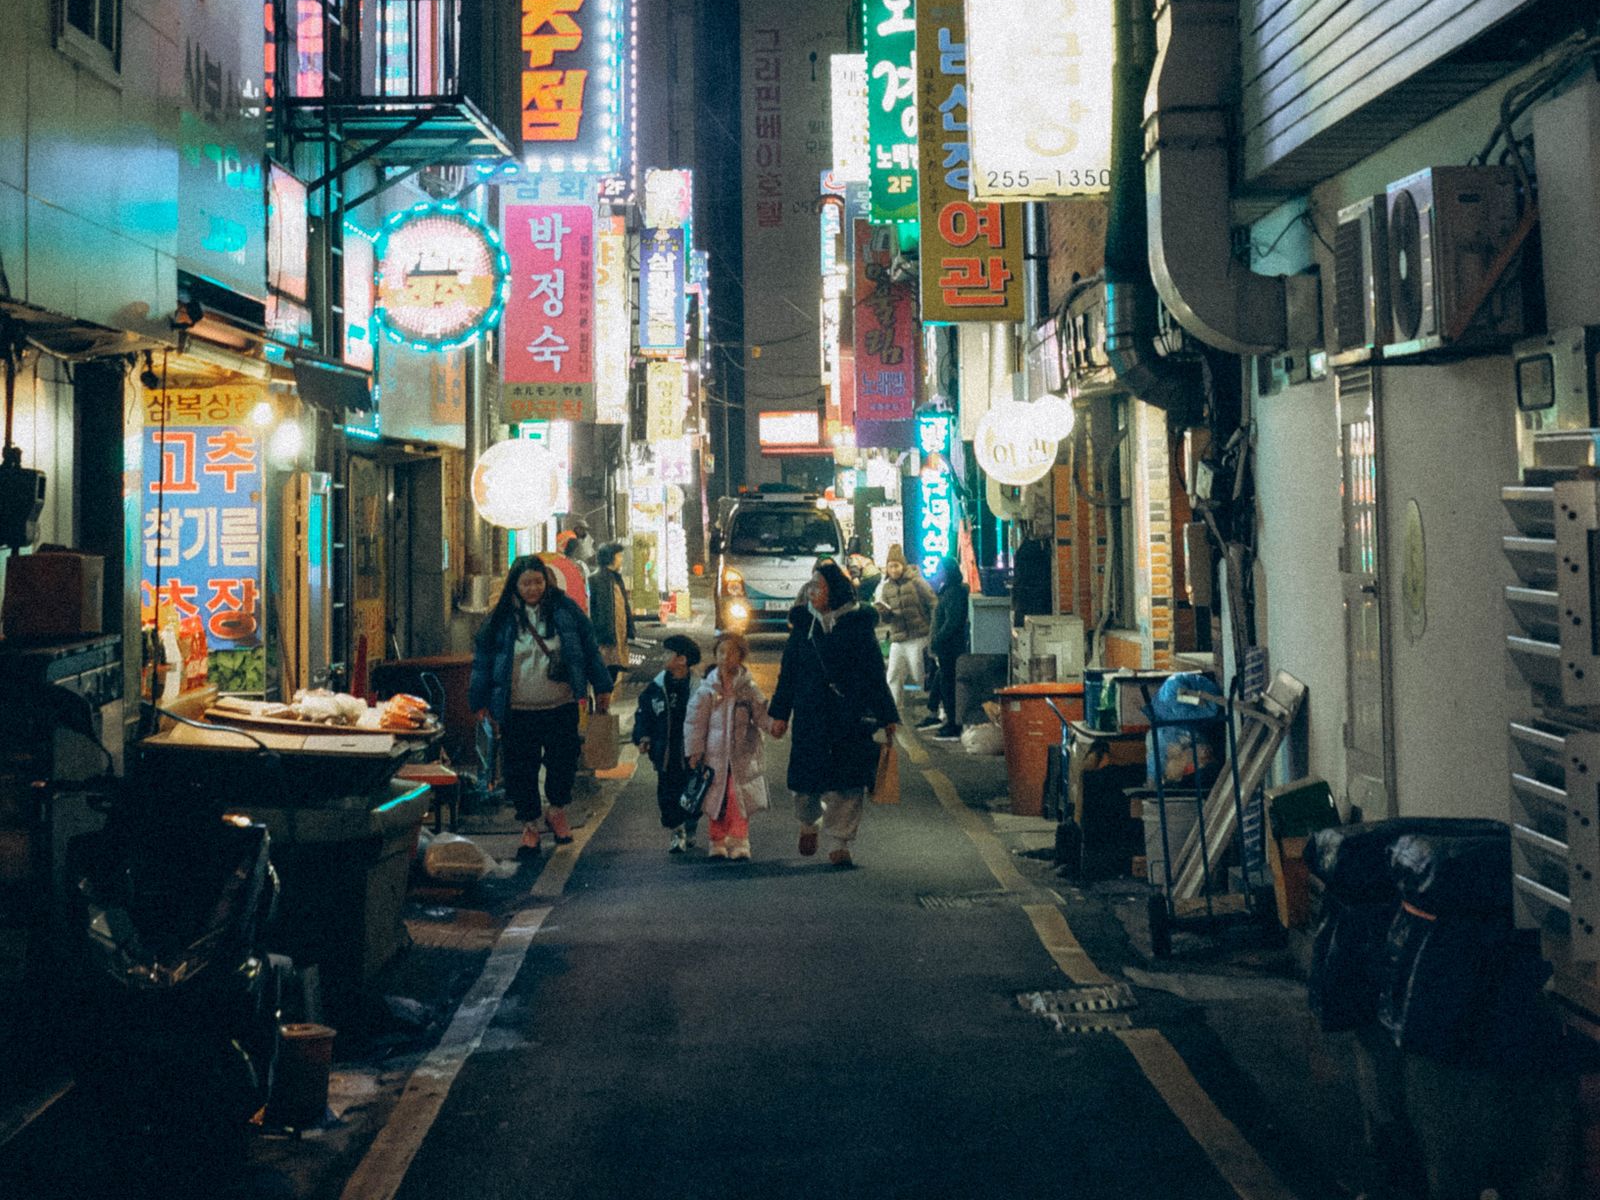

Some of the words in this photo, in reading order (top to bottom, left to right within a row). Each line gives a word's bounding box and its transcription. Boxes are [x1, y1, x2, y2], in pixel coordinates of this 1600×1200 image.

[604, 179, 626, 197] 2F
[886, 174, 913, 195] 2F
[986, 168, 1111, 188] 255-1350
[937, 201, 1011, 308] 여관
[526, 211, 573, 375] 박정숙
[149, 430, 257, 494] 고추
[142, 506, 261, 568] 참기름
